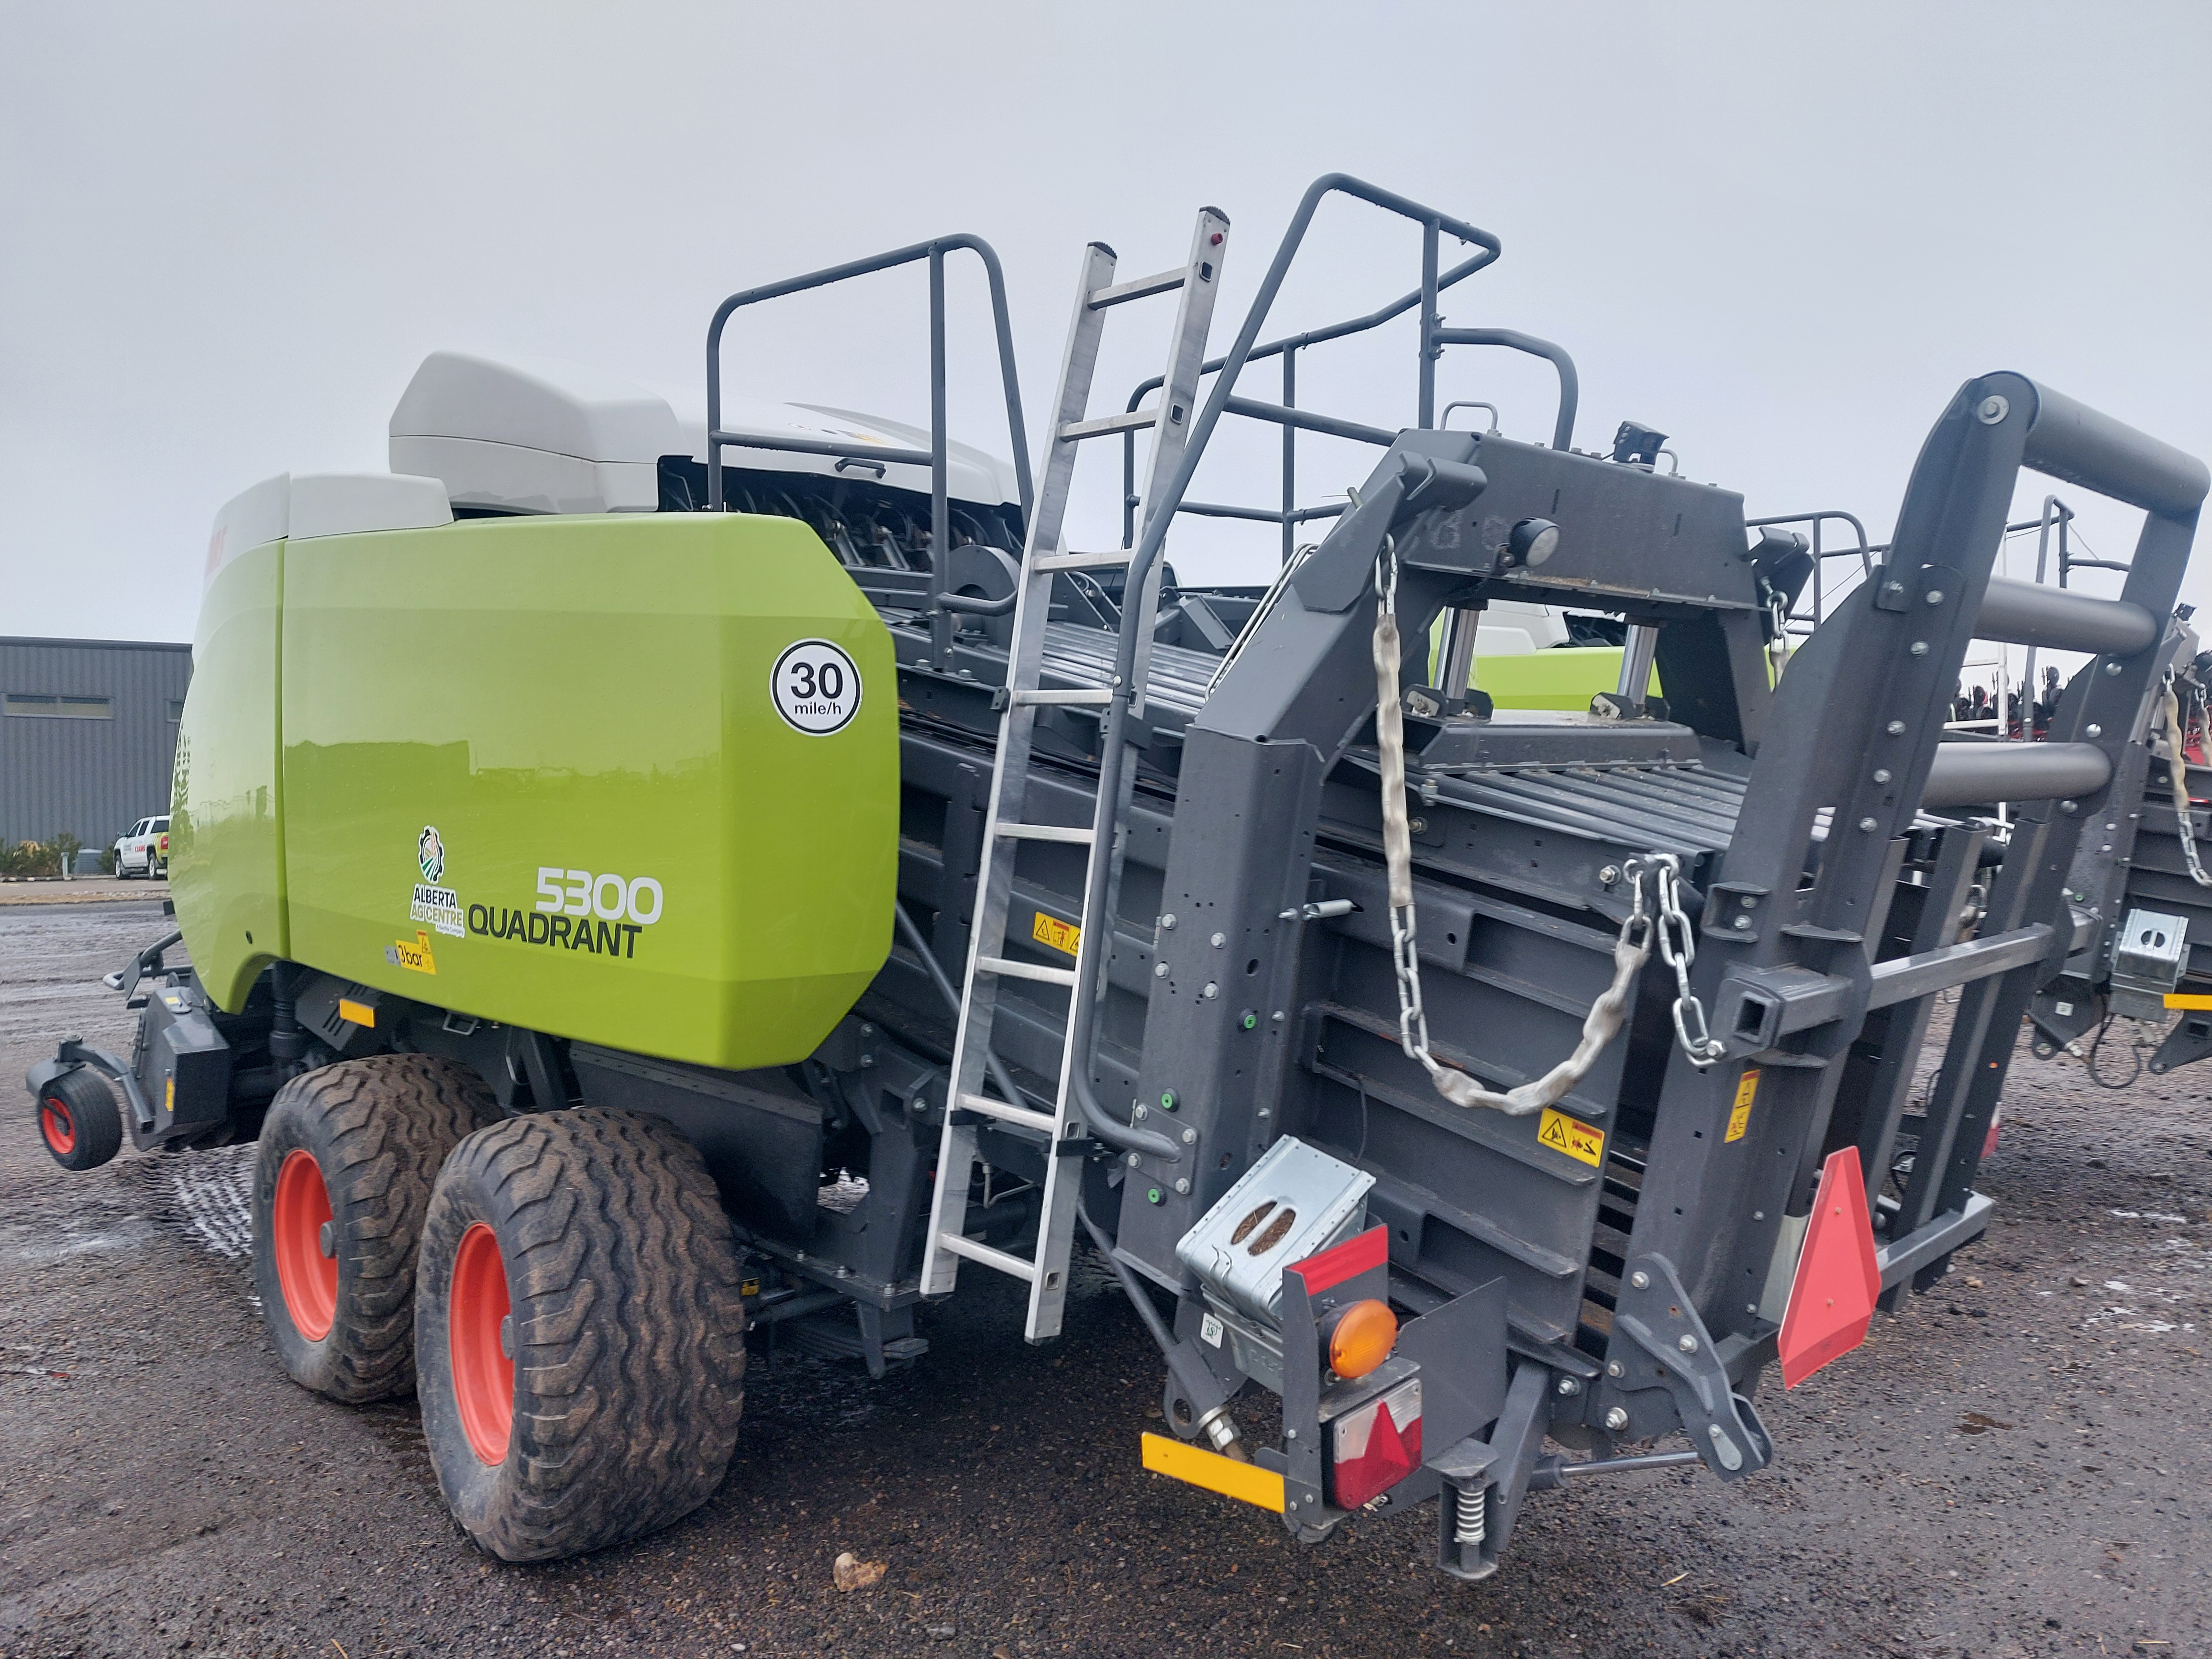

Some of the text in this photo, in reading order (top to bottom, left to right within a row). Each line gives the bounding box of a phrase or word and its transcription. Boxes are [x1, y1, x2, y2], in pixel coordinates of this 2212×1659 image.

[791, 662, 843, 699] 30
[795, 701, 841, 715] mile/h
[414, 887, 456, 908] ALBERTA
[536, 866, 663, 925] 5300
[468, 903, 642, 959] QUADRANT
